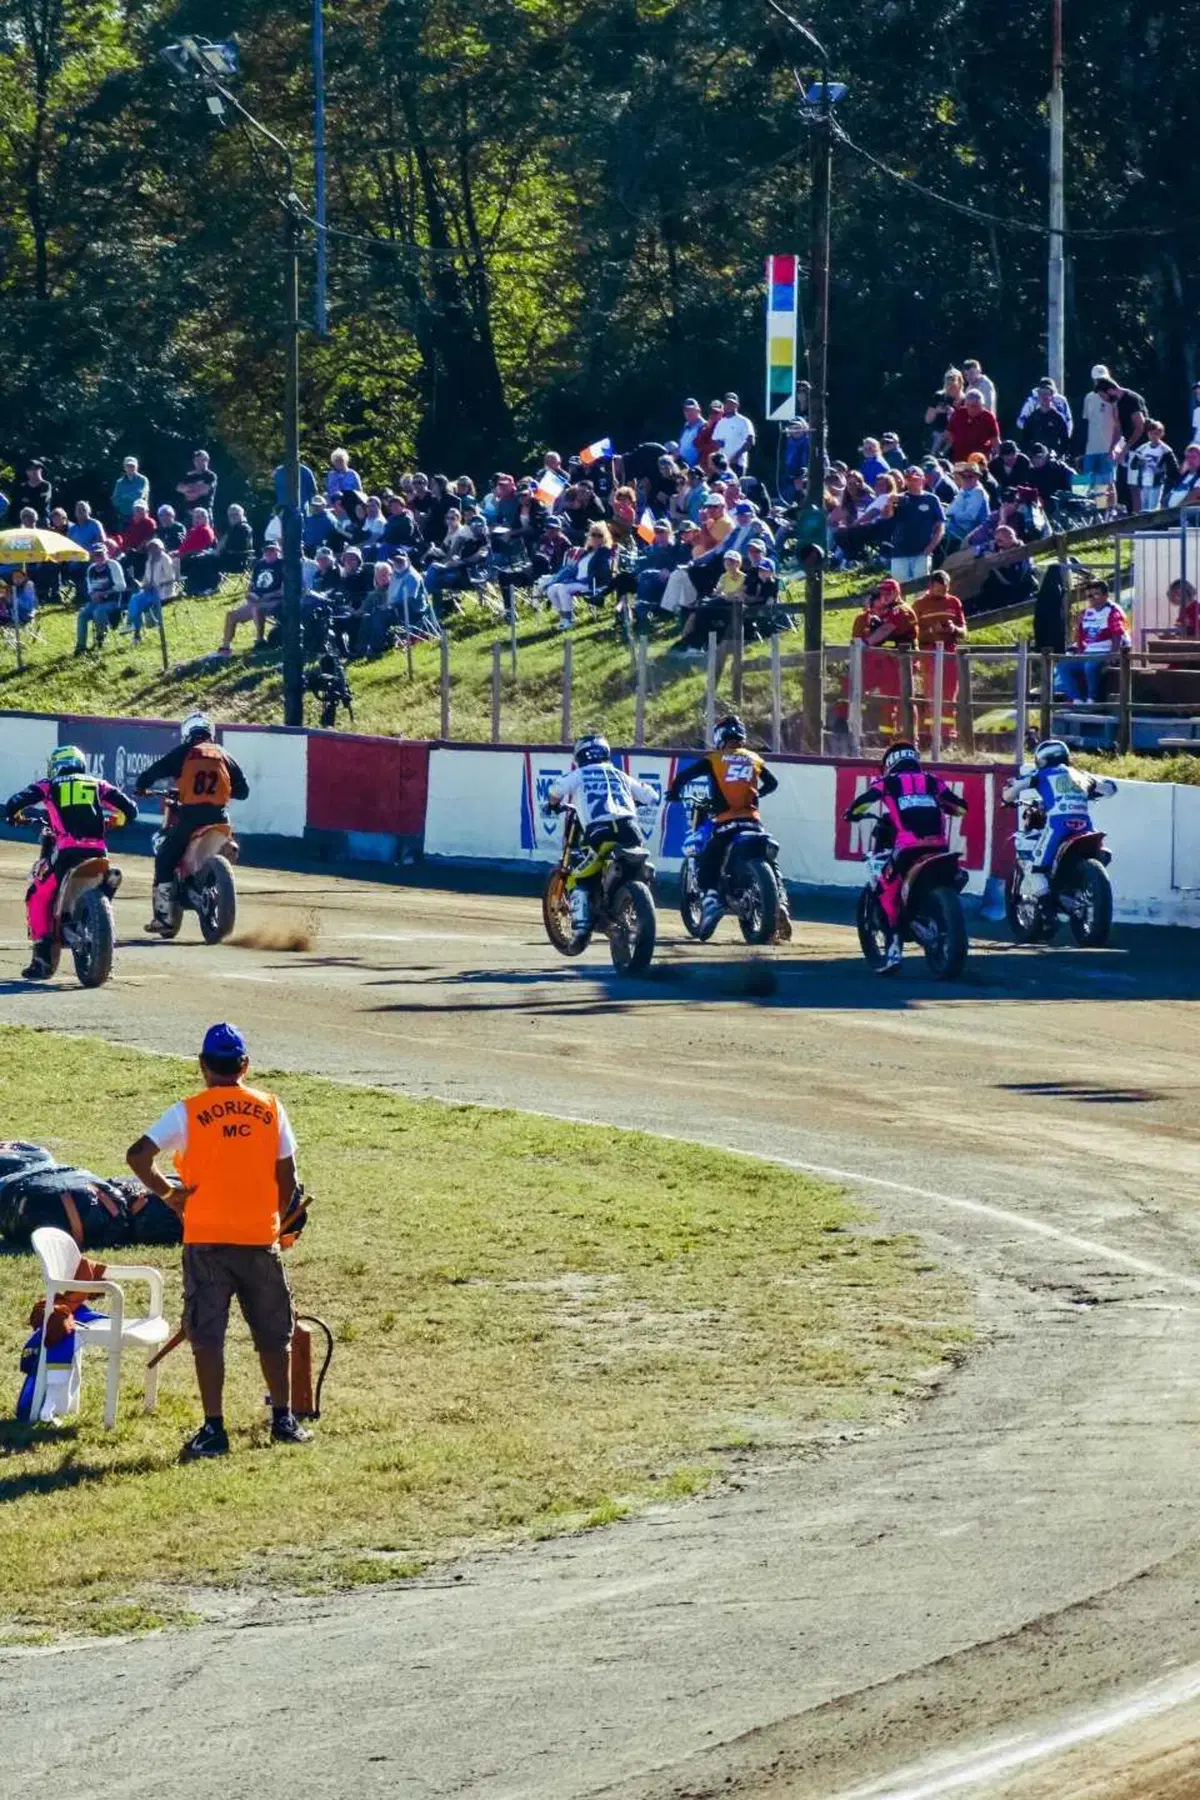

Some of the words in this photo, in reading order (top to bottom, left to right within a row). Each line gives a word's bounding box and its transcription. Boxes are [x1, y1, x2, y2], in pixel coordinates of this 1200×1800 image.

[725, 764, 754, 782] 54
[58, 780, 97, 808] 16
[196, 1101, 274, 1127] MORIZES
[222, 1124, 252, 1138] MC
